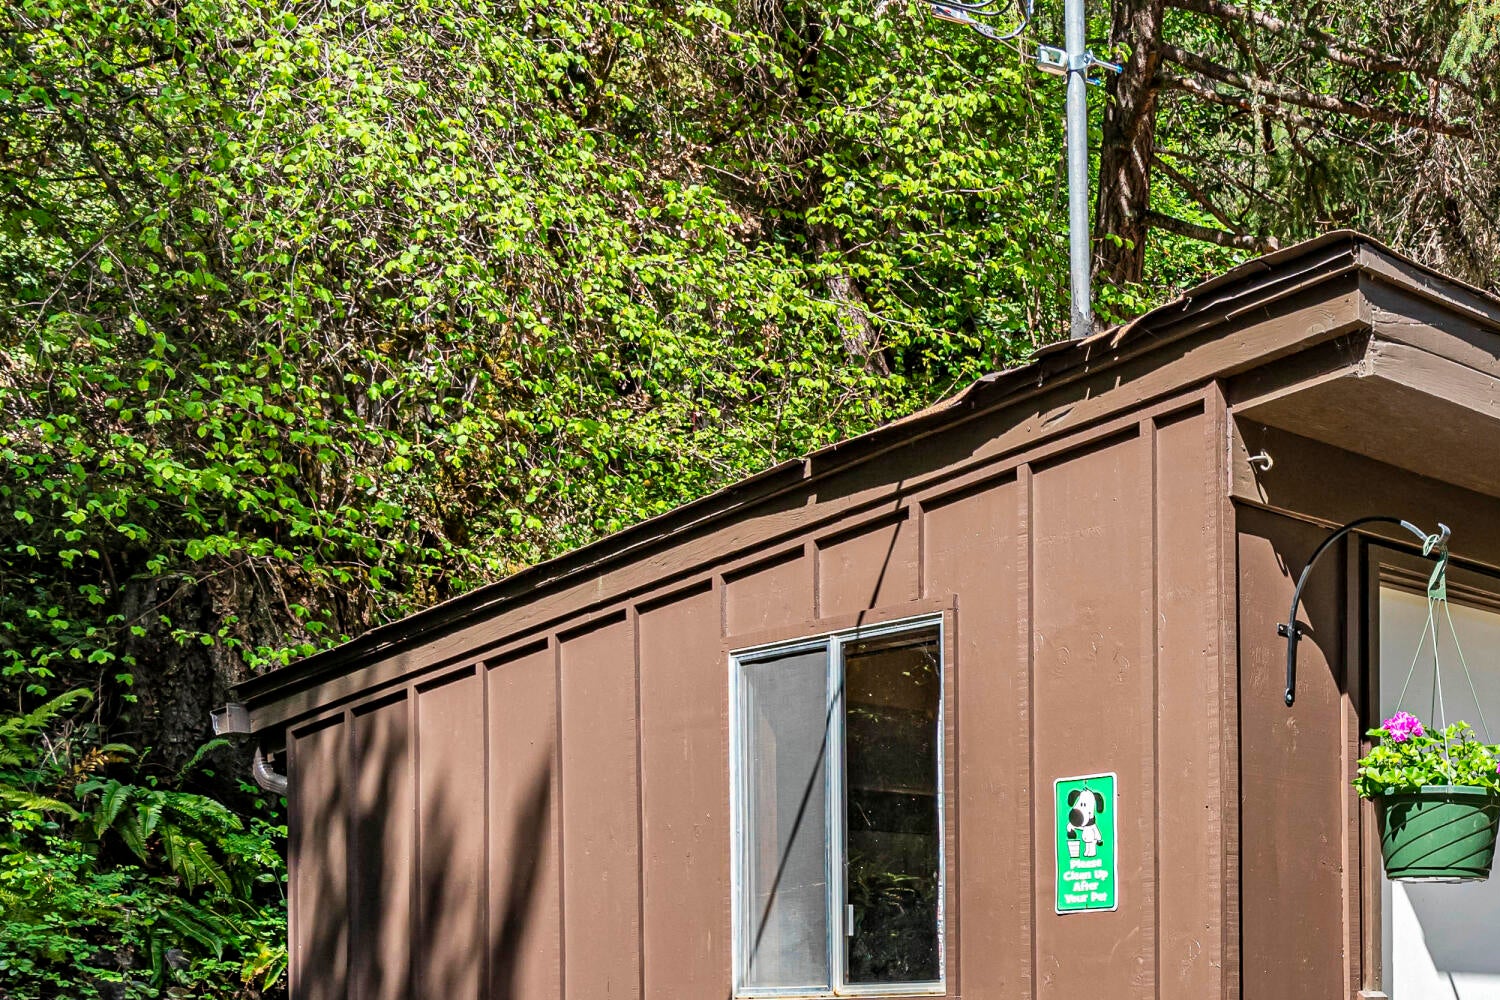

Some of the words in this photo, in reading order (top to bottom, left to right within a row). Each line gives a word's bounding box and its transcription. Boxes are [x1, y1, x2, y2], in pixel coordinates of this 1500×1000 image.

[1063, 871, 1092, 881] Clean
[1093, 870, 1109, 881] Up
[1072, 881, 1099, 892] After
[1090, 891, 1108, 902] Pet
